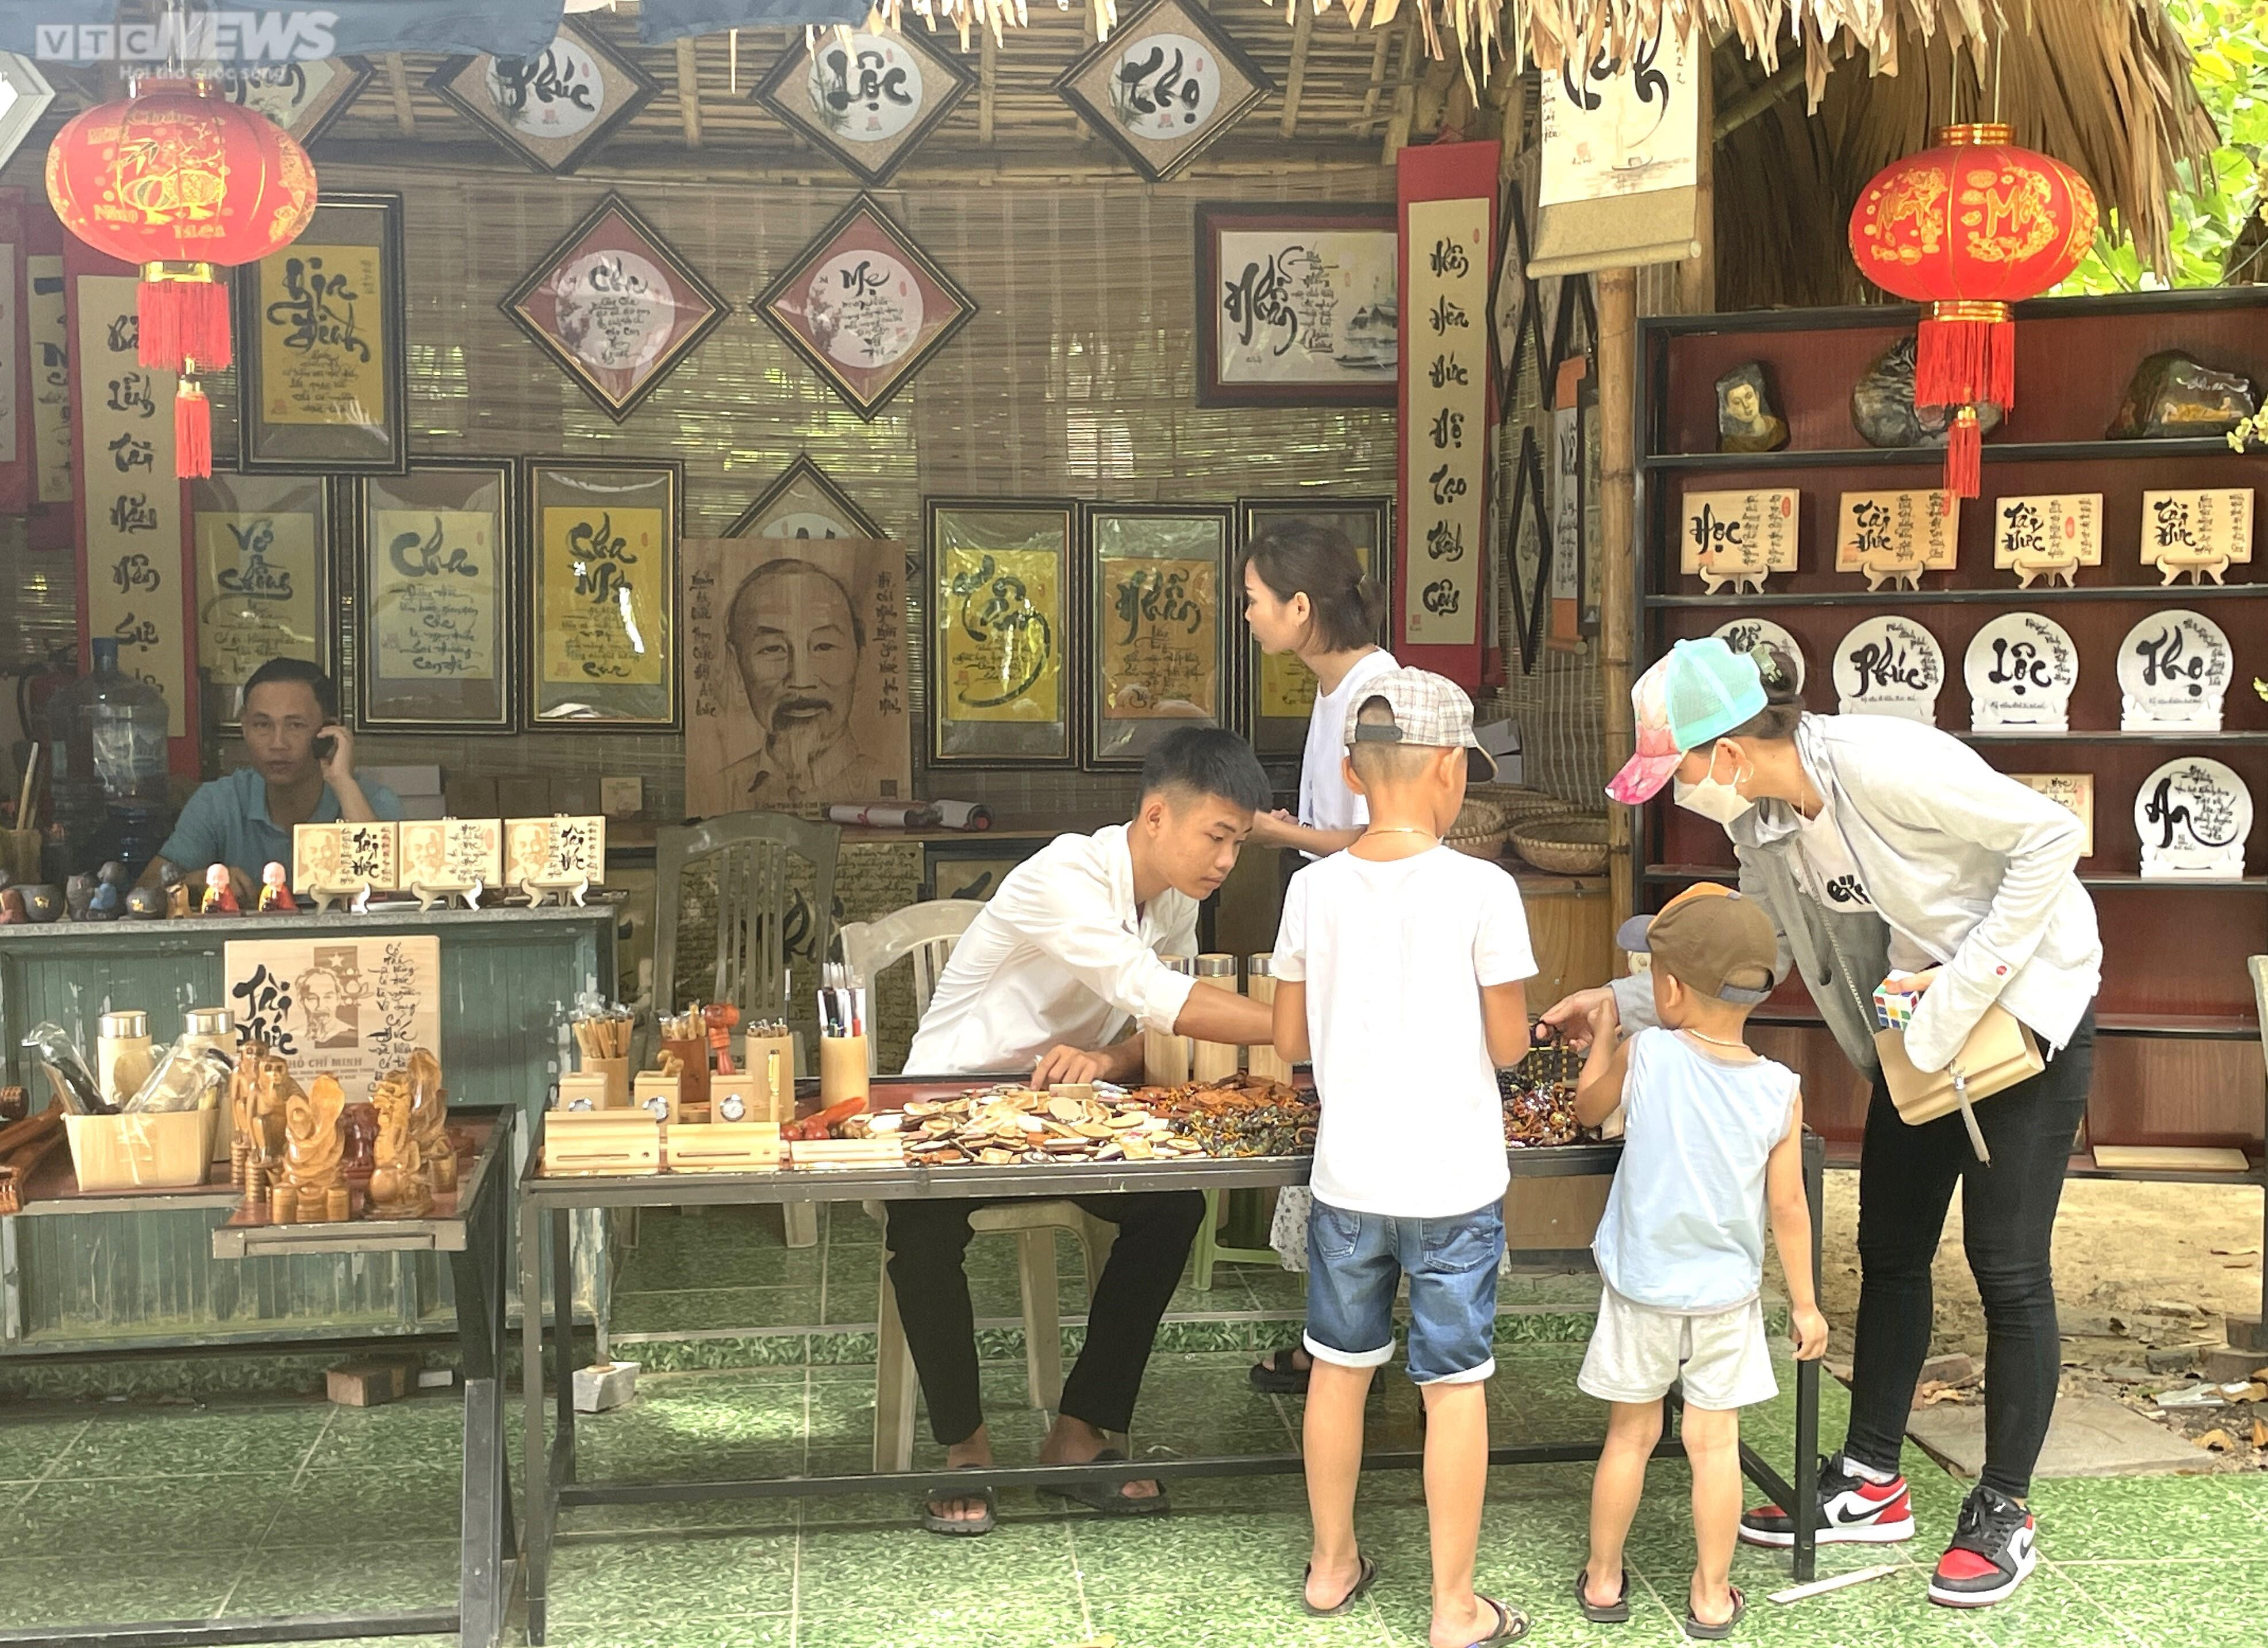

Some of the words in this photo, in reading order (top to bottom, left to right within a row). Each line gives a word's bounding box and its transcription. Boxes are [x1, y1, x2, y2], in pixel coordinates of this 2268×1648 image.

[827, 49, 913, 111] Lộc
[1121, 46, 1200, 124] Thọ
[589, 257, 648, 294] Cha
[839, 260, 890, 297] Mẹ
[1428, 351, 1469, 388] Đức
[1690, 503, 1742, 554] Học
[1853, 500, 1890, 532] Tài
[2154, 495, 2188, 526] Tài
[389, 516, 479, 577] Cha
[566, 511, 638, 563] Cha
[1848, 527, 1893, 552] Đức
[567, 562, 632, 604] Mẹ
[1850, 636, 1928, 697] Phúc
[1988, 638, 2052, 696] Lộc
[2136, 625, 2203, 696] Thọ
[2145, 773, 2239, 848] An
[386, 942, 401, 956] Có
[232, 964, 292, 1021] Tài
[235, 1012, 298, 1055] Đức
[309, 1055, 328, 1067] CHÍ
[332, 1057, 363, 1067] MINH
